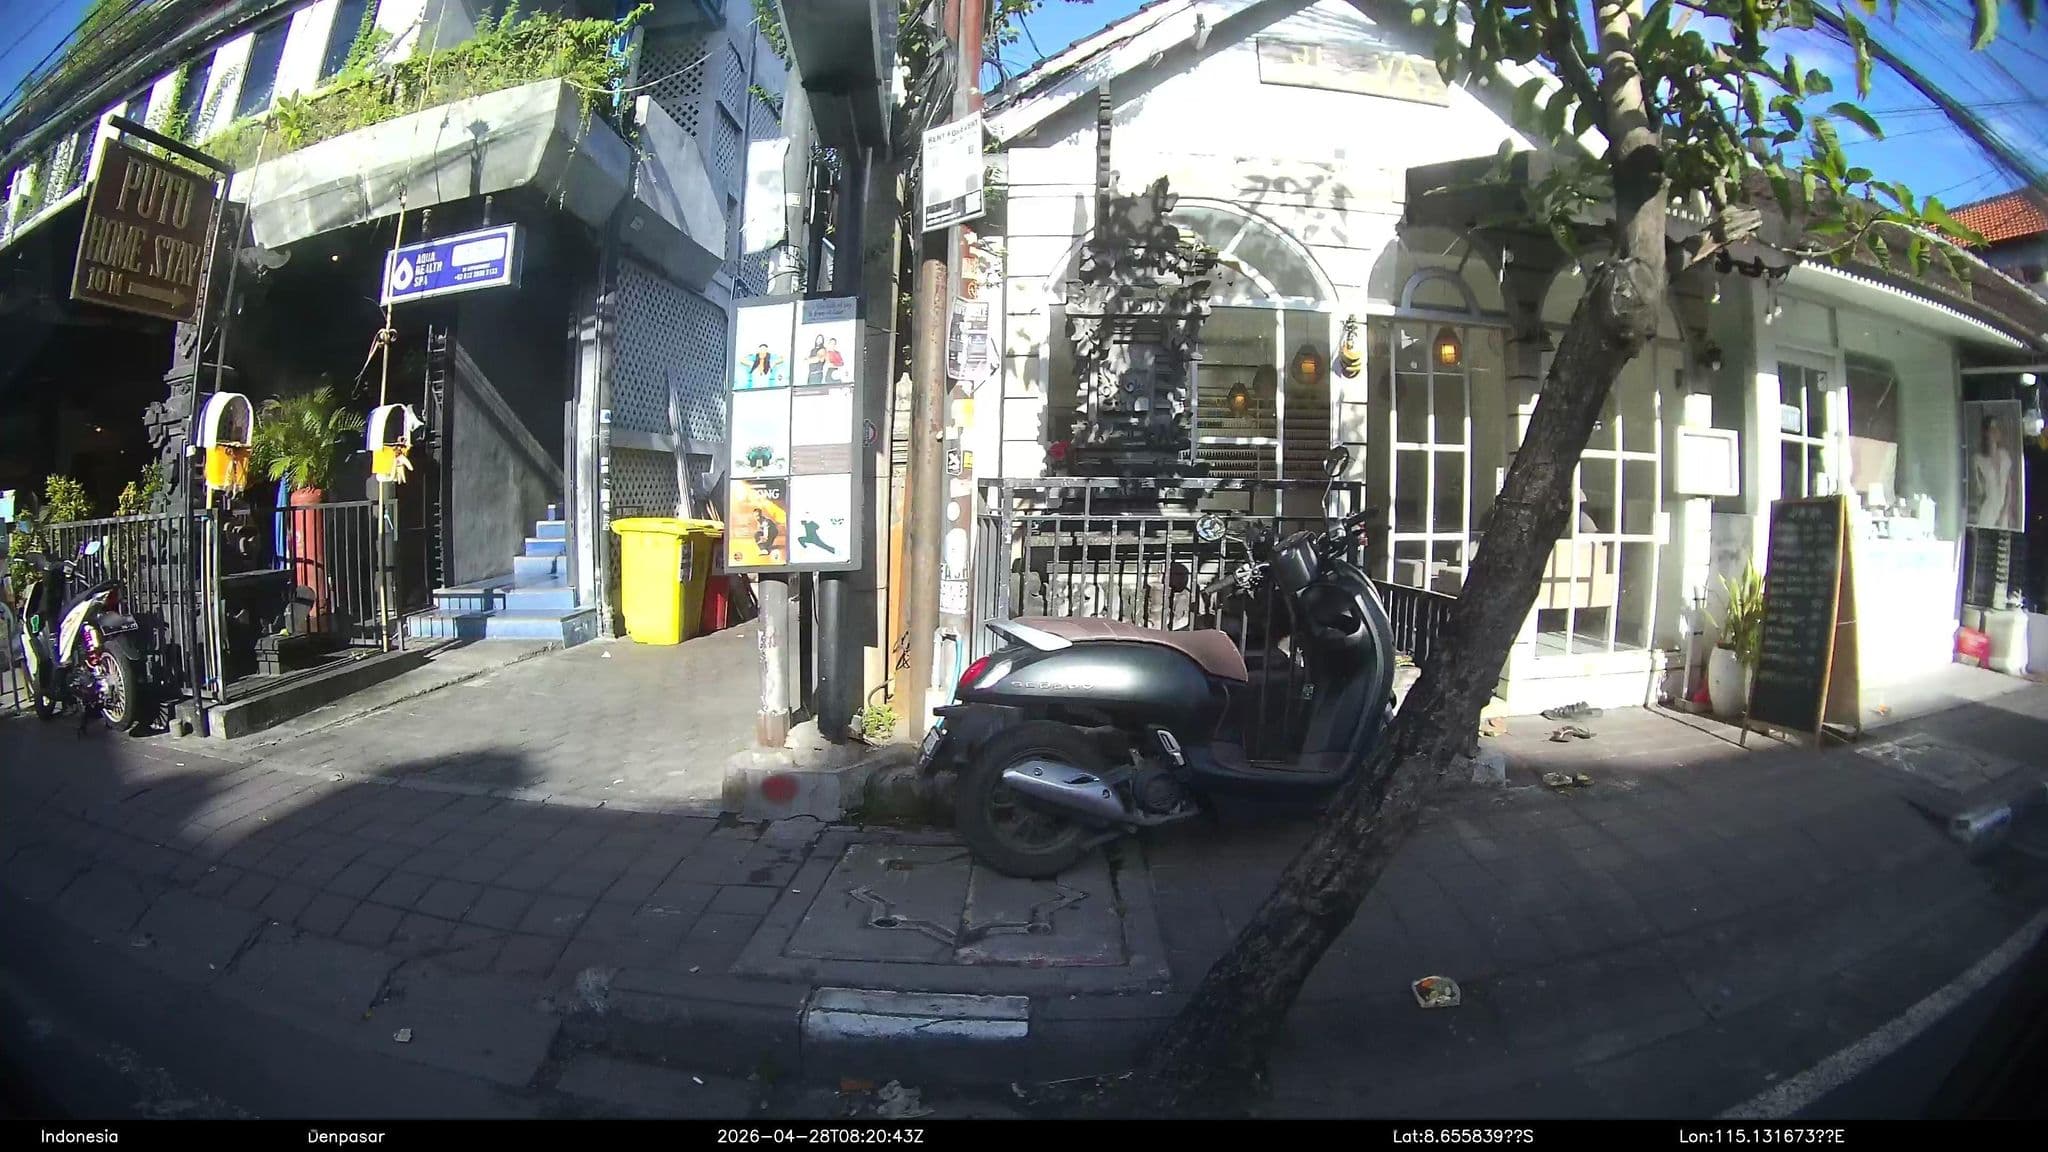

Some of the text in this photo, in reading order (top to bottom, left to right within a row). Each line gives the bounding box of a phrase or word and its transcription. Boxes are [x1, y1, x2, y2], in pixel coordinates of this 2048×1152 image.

[116, 156, 194, 229] PUTU
[86, 212, 201, 286] HOME STAY
[416, 252, 435, 265] AQUA
[415, 261, 443, 275] HEALTH
[86, 266, 107, 292] 10
[414, 276, 428, 288] SPA
